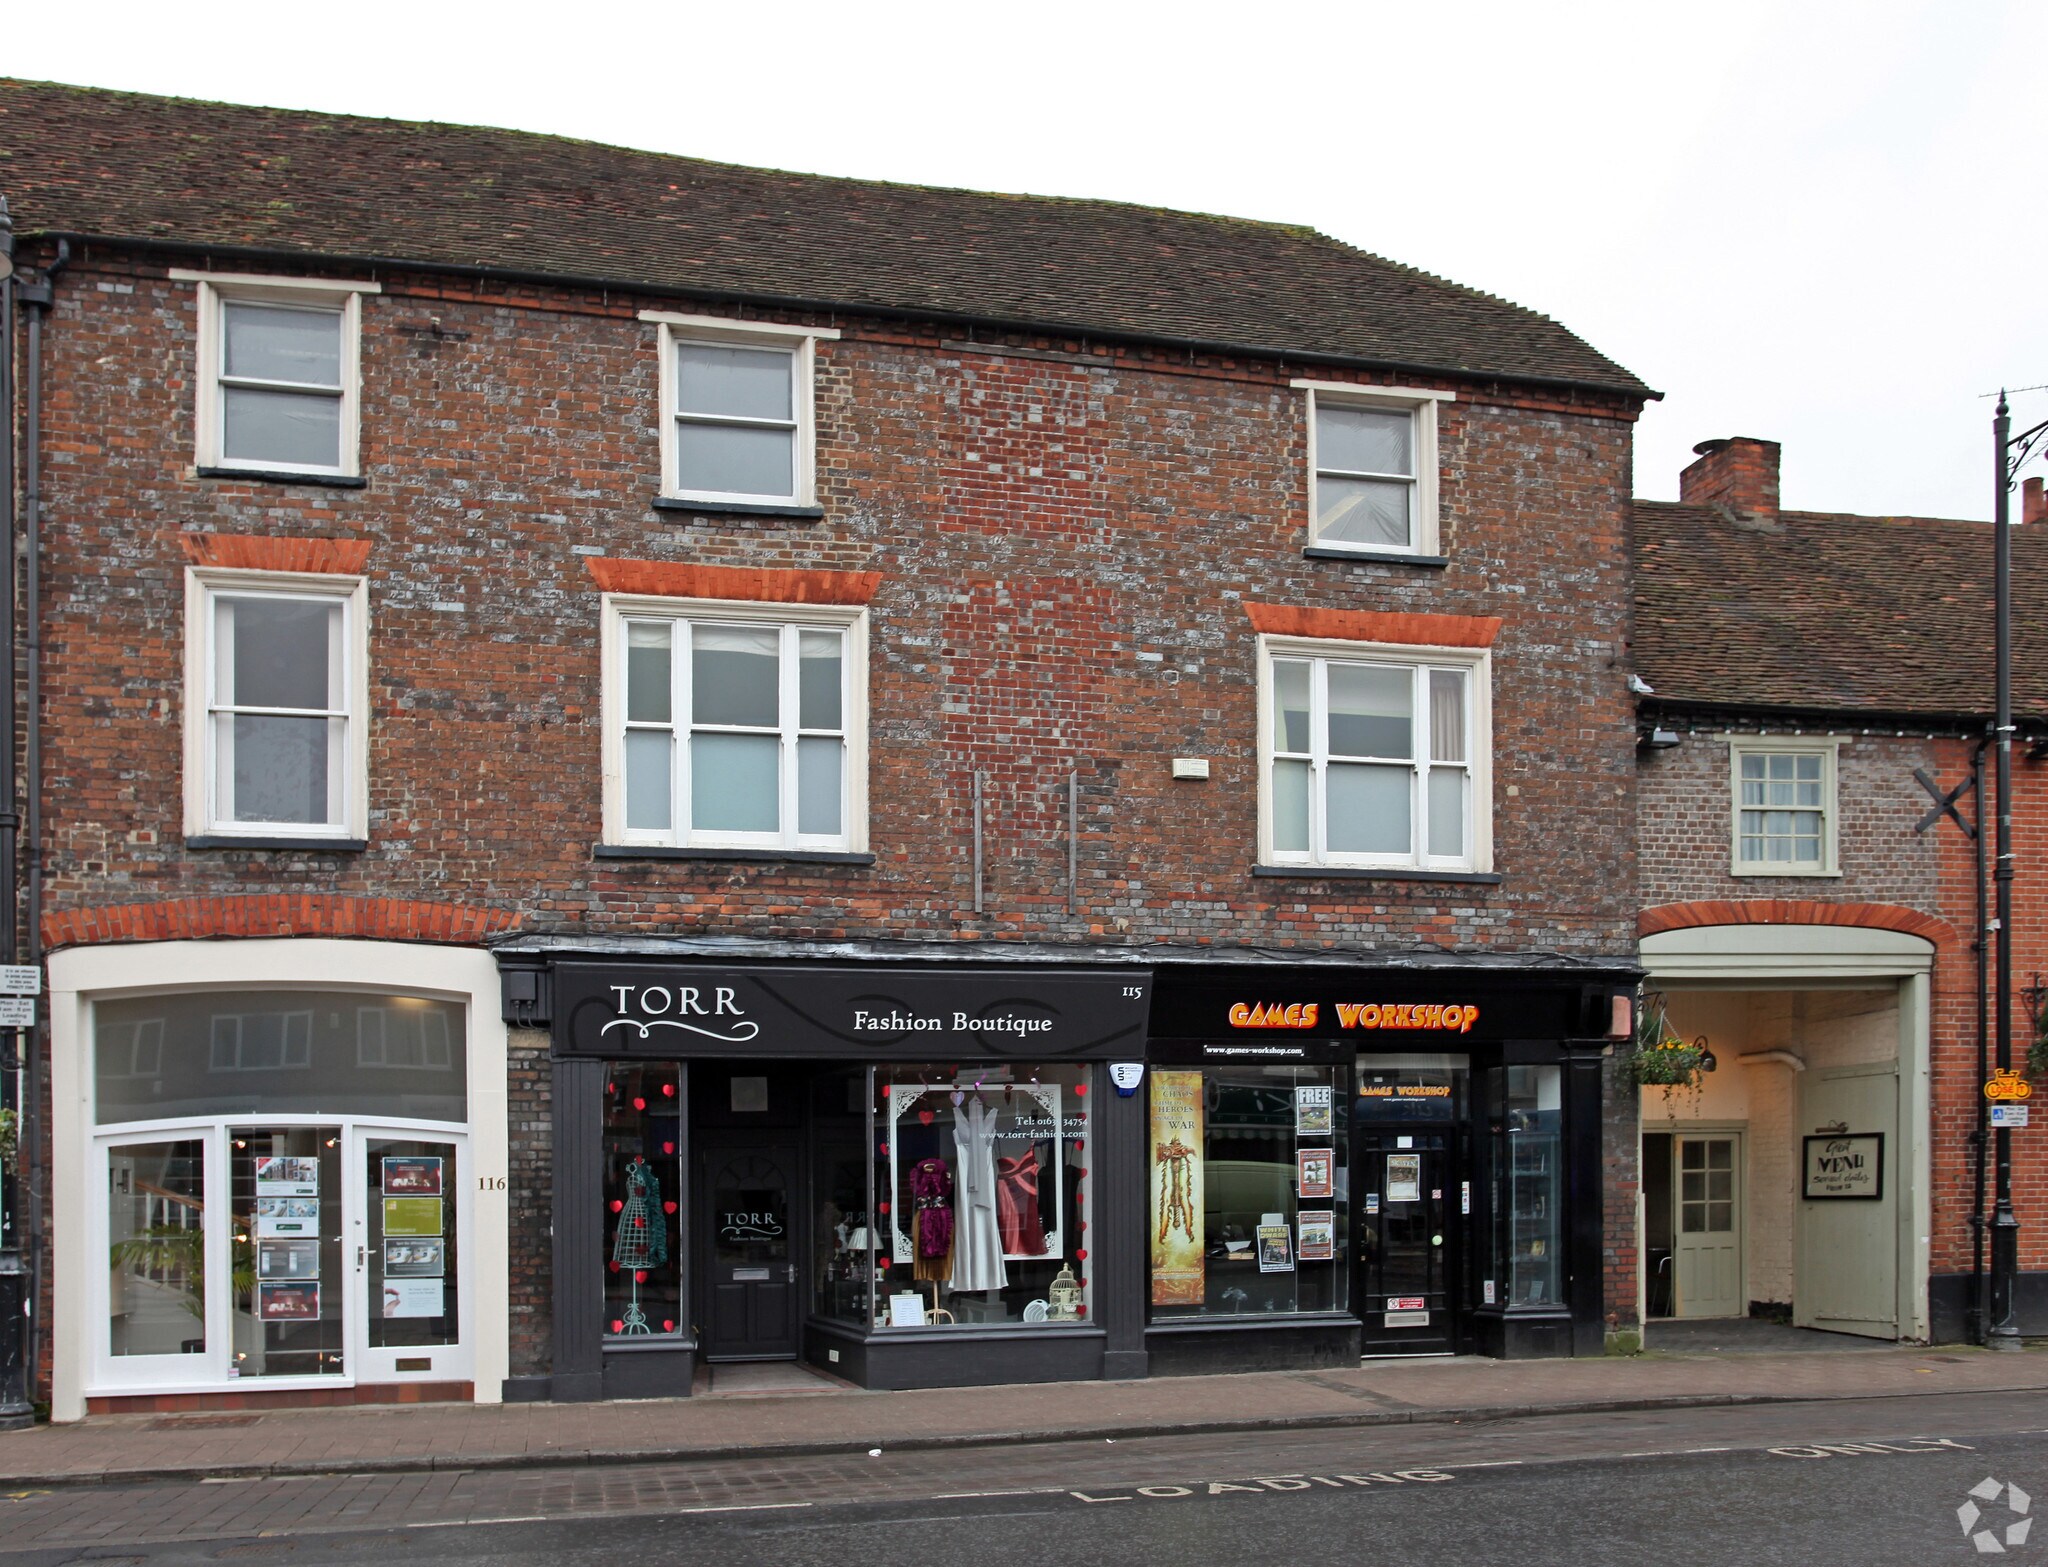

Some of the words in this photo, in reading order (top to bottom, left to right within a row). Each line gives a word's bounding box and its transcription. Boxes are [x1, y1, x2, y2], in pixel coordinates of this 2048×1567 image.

[1122, 986, 1142, 1000] 115
[610, 985, 745, 1015] TORR
[1228, 1000, 1320, 1029] GAMES
[1335, 1002, 1480, 1034] WORKSHOP
[853, 1010, 942, 1031] Fashion
[951, 1012, 1053, 1038] Boutique
[1205, 1046, 1303, 1056] www.games-workshop.com
[1163, 1090, 1194, 1098] CHAOS
[1299, 1088, 1329, 1104] FREE
[1360, 1086, 1393, 1097] GAMES
[1396, 1086, 1451, 1098] WORKSHOP
[1991, 1085, 2014, 1094] LOSE
[2016, 1085, 2025, 1094] IT
[1015, 1116, 1035, 1126] Tel:
[1037, 1116, 1060, 1127] 0163
[1063, 1118, 1088, 1127] 34754
[1169, 1120, 1196, 1130] WAR
[978, 1128, 1088, 1139] www.torr-fashion.com
[1818, 1153, 1864, 1174] MENU
[478, 1176, 507, 1191] 116
[1844, 1172, 1870, 1185] daily
[724, 1212, 777, 1225] TORR
[1766, 1438, 1976, 1459] ONLY
[1069, 1469, 1456, 1503] LOADING
